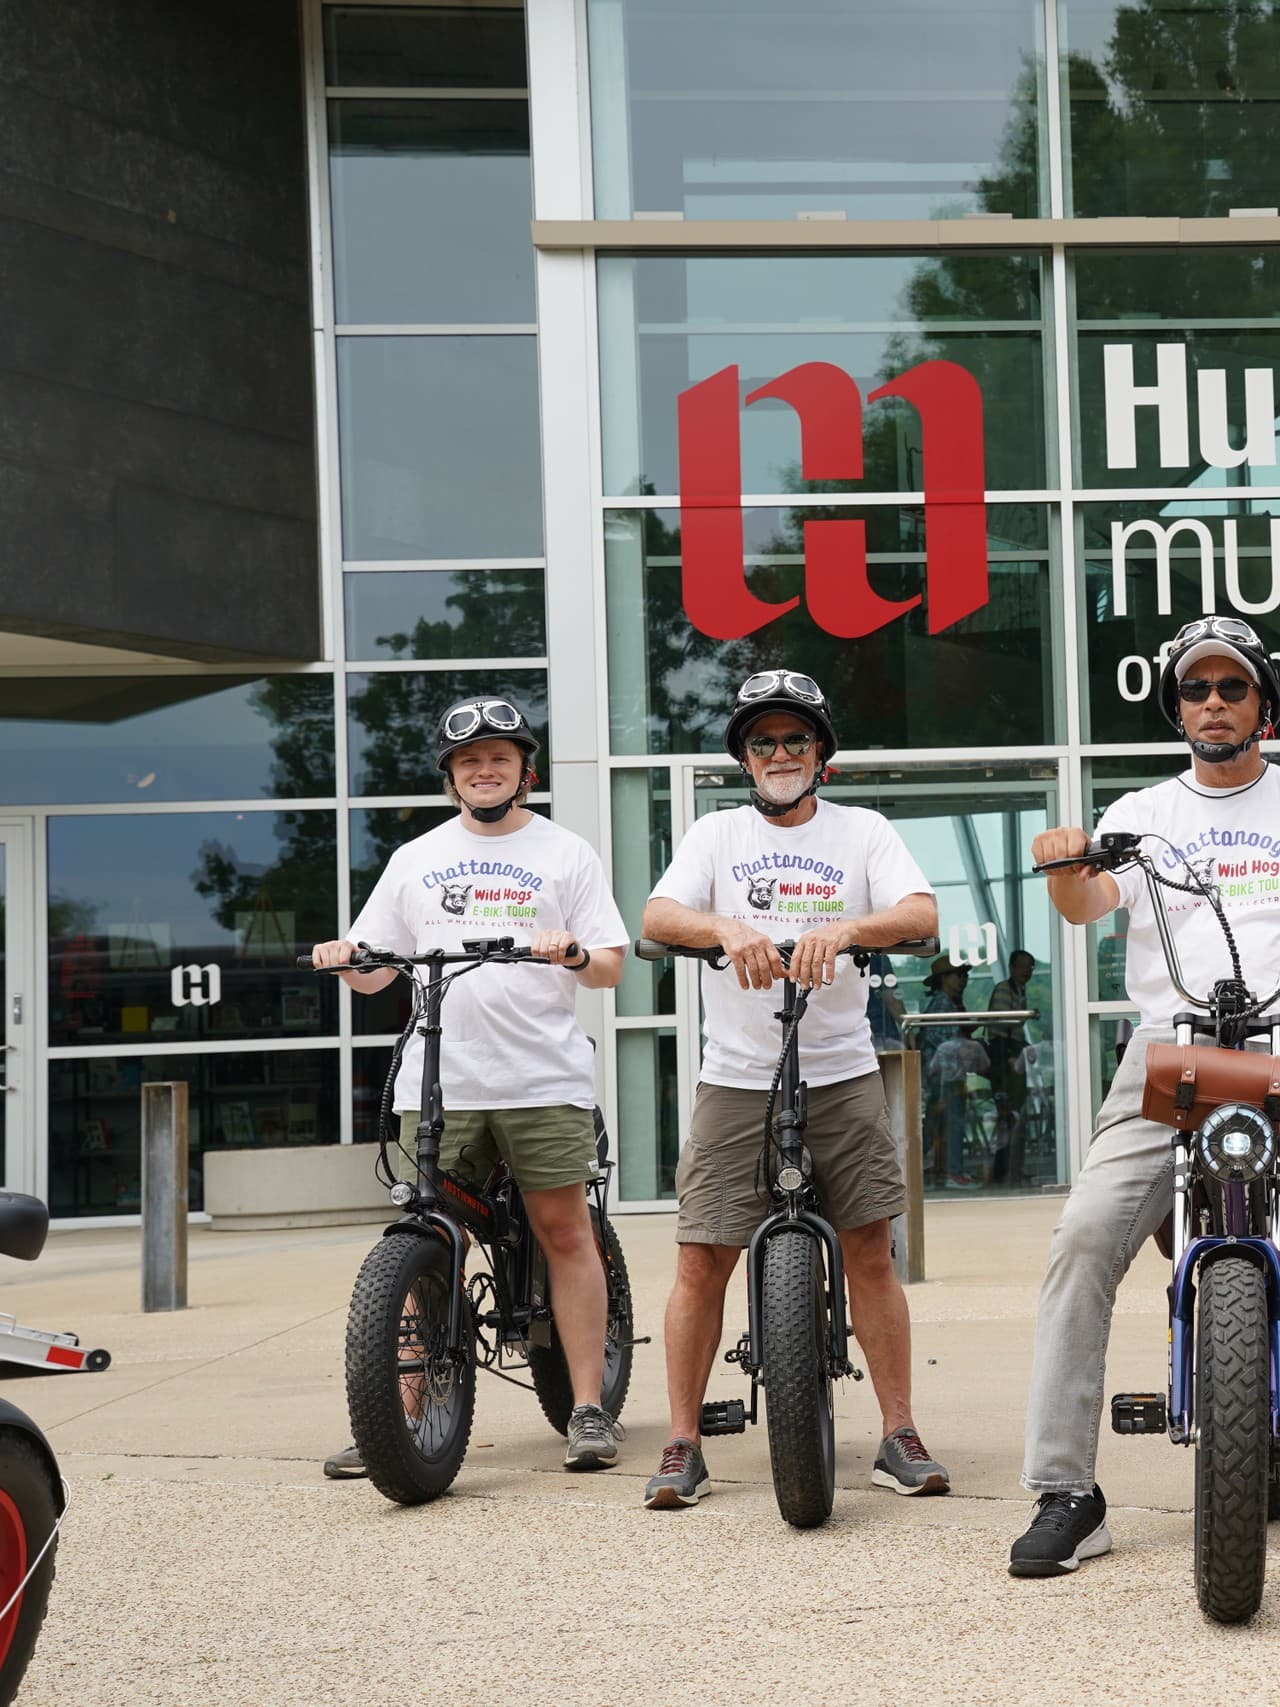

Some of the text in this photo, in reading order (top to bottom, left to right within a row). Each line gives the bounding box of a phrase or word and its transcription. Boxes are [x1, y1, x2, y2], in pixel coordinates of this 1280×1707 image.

[422, 859, 543, 891] Chattanooga
[731, 852, 845, 885] Chattanooga
[1218, 860, 1248, 877] Wild
[474, 888, 532, 905] Wild Hogs
[779, 882, 837, 900] Wild Hogs
[1218, 881, 1254, 897] E-BIKE
[506, 905, 537, 918] TOURS
[777, 901, 845, 913] E-BIKE TOURS
